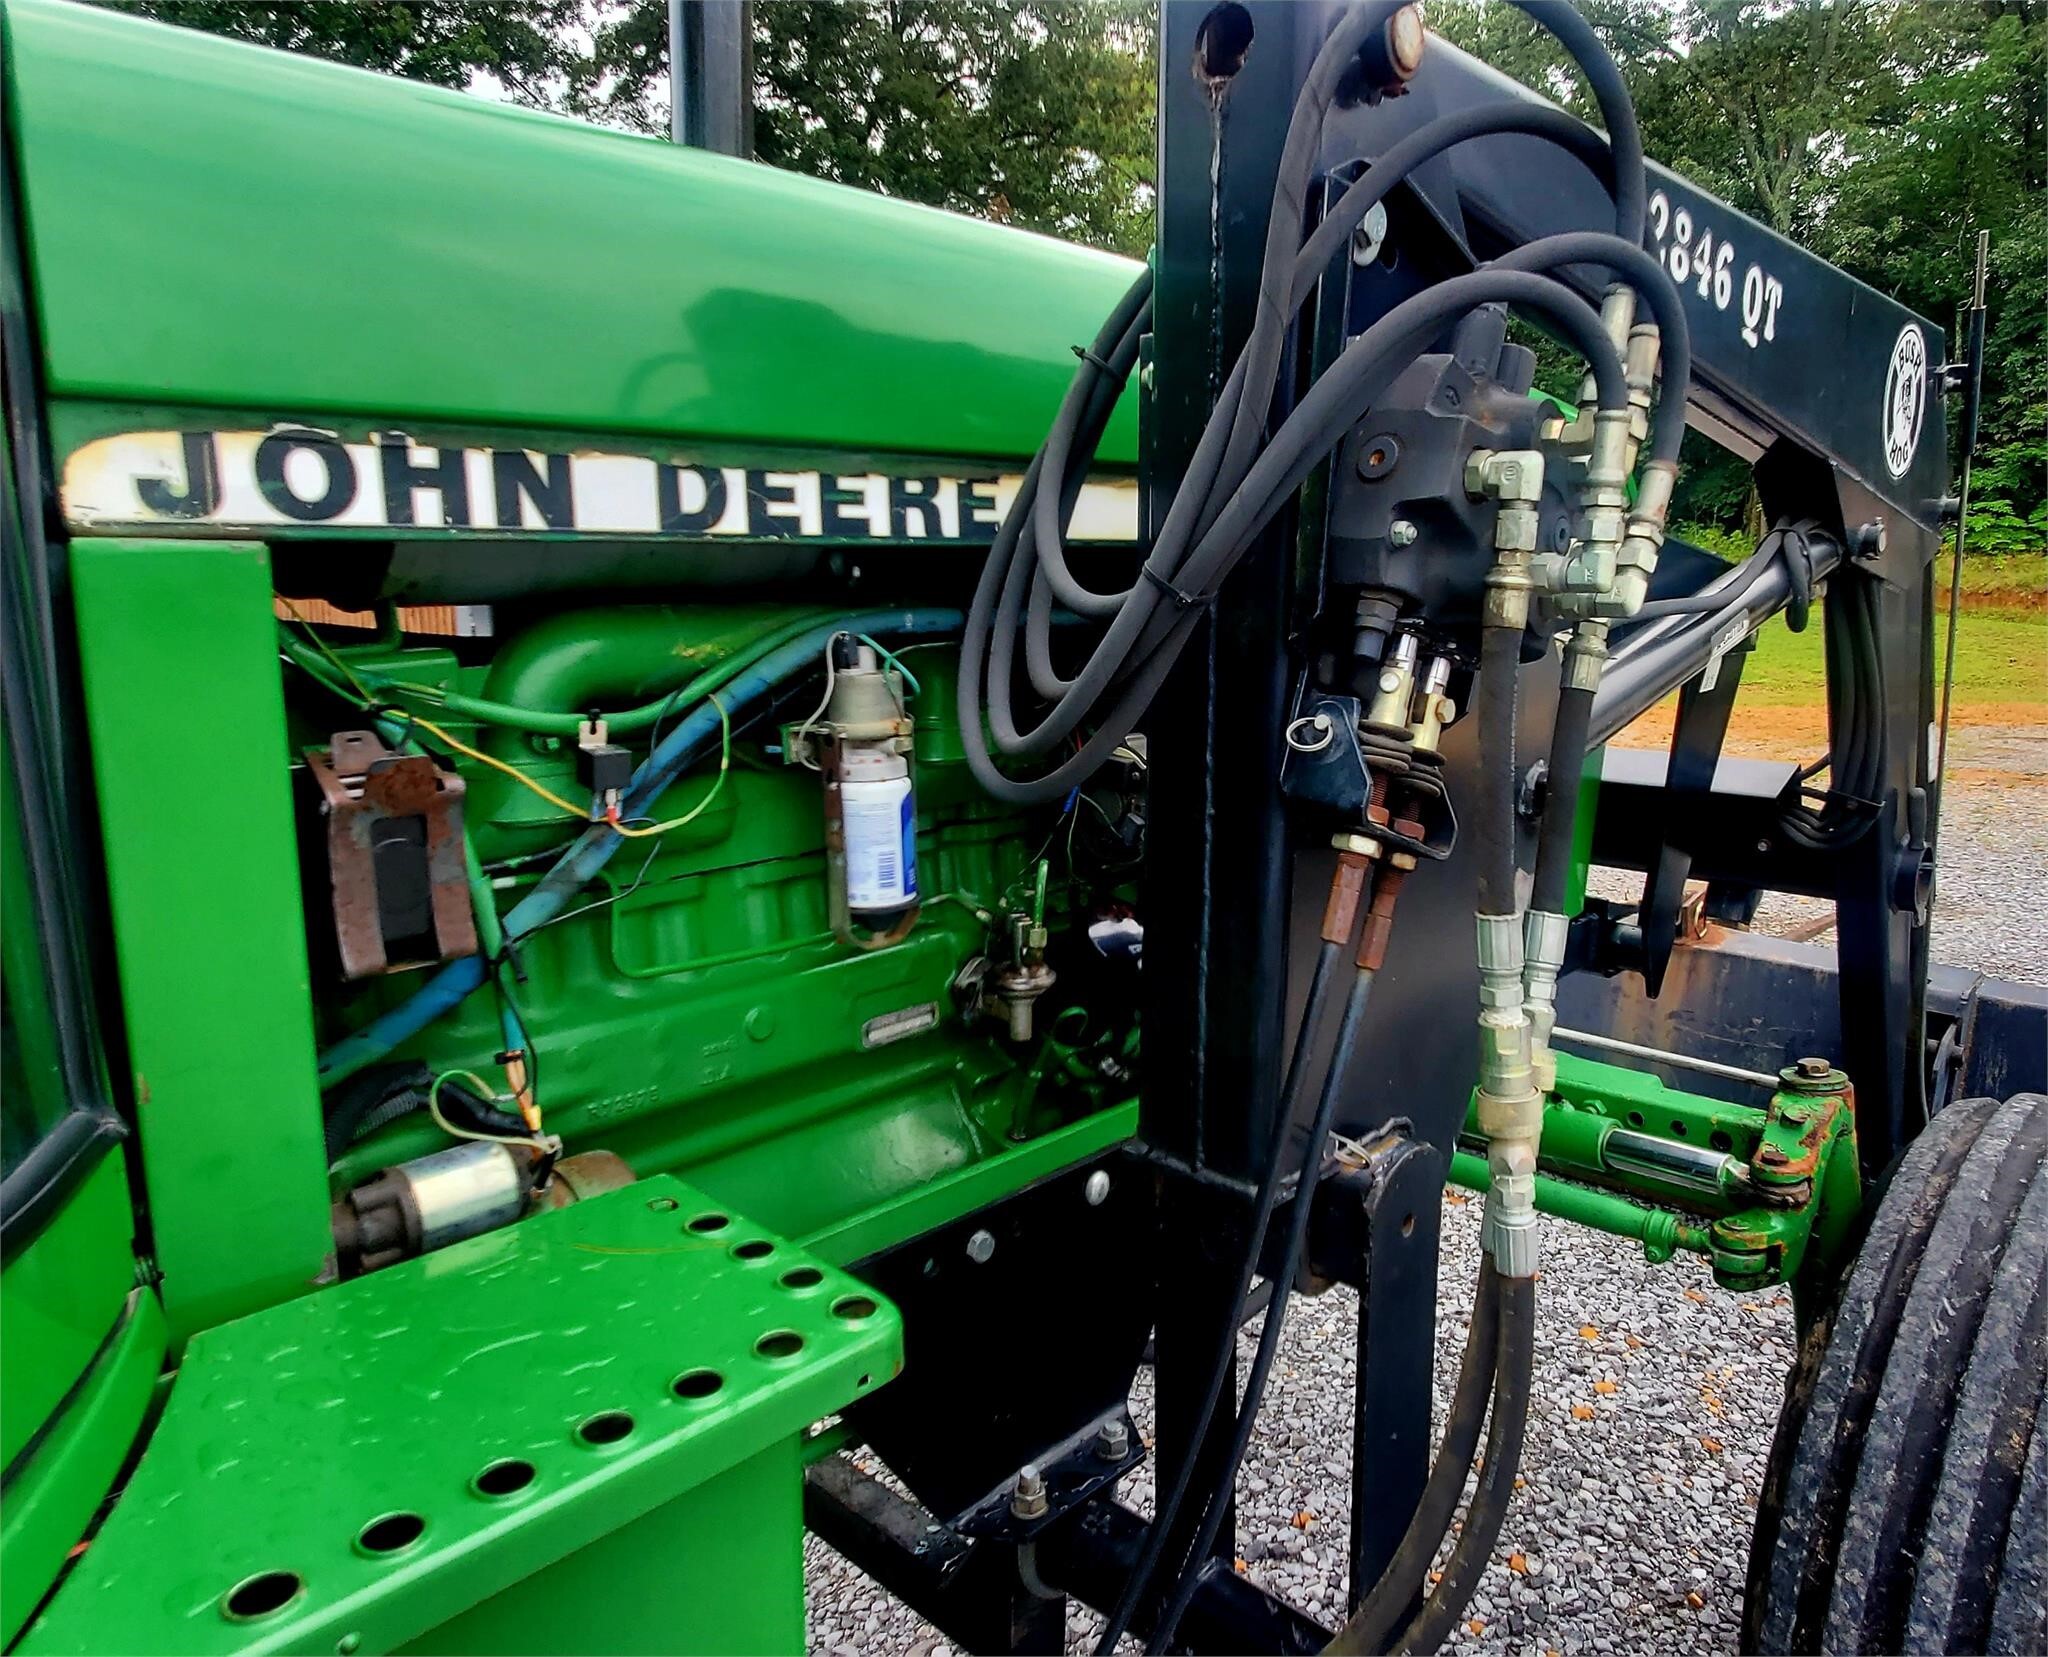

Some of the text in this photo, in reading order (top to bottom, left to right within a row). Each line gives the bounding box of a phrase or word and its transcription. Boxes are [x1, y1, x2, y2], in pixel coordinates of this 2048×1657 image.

[1741, 264, 1783, 349] QT
[1898, 339, 1922, 378] BUSH
[130, 427, 1002, 539] JOHN DEERE
[1889, 437, 1909, 468] HOG
